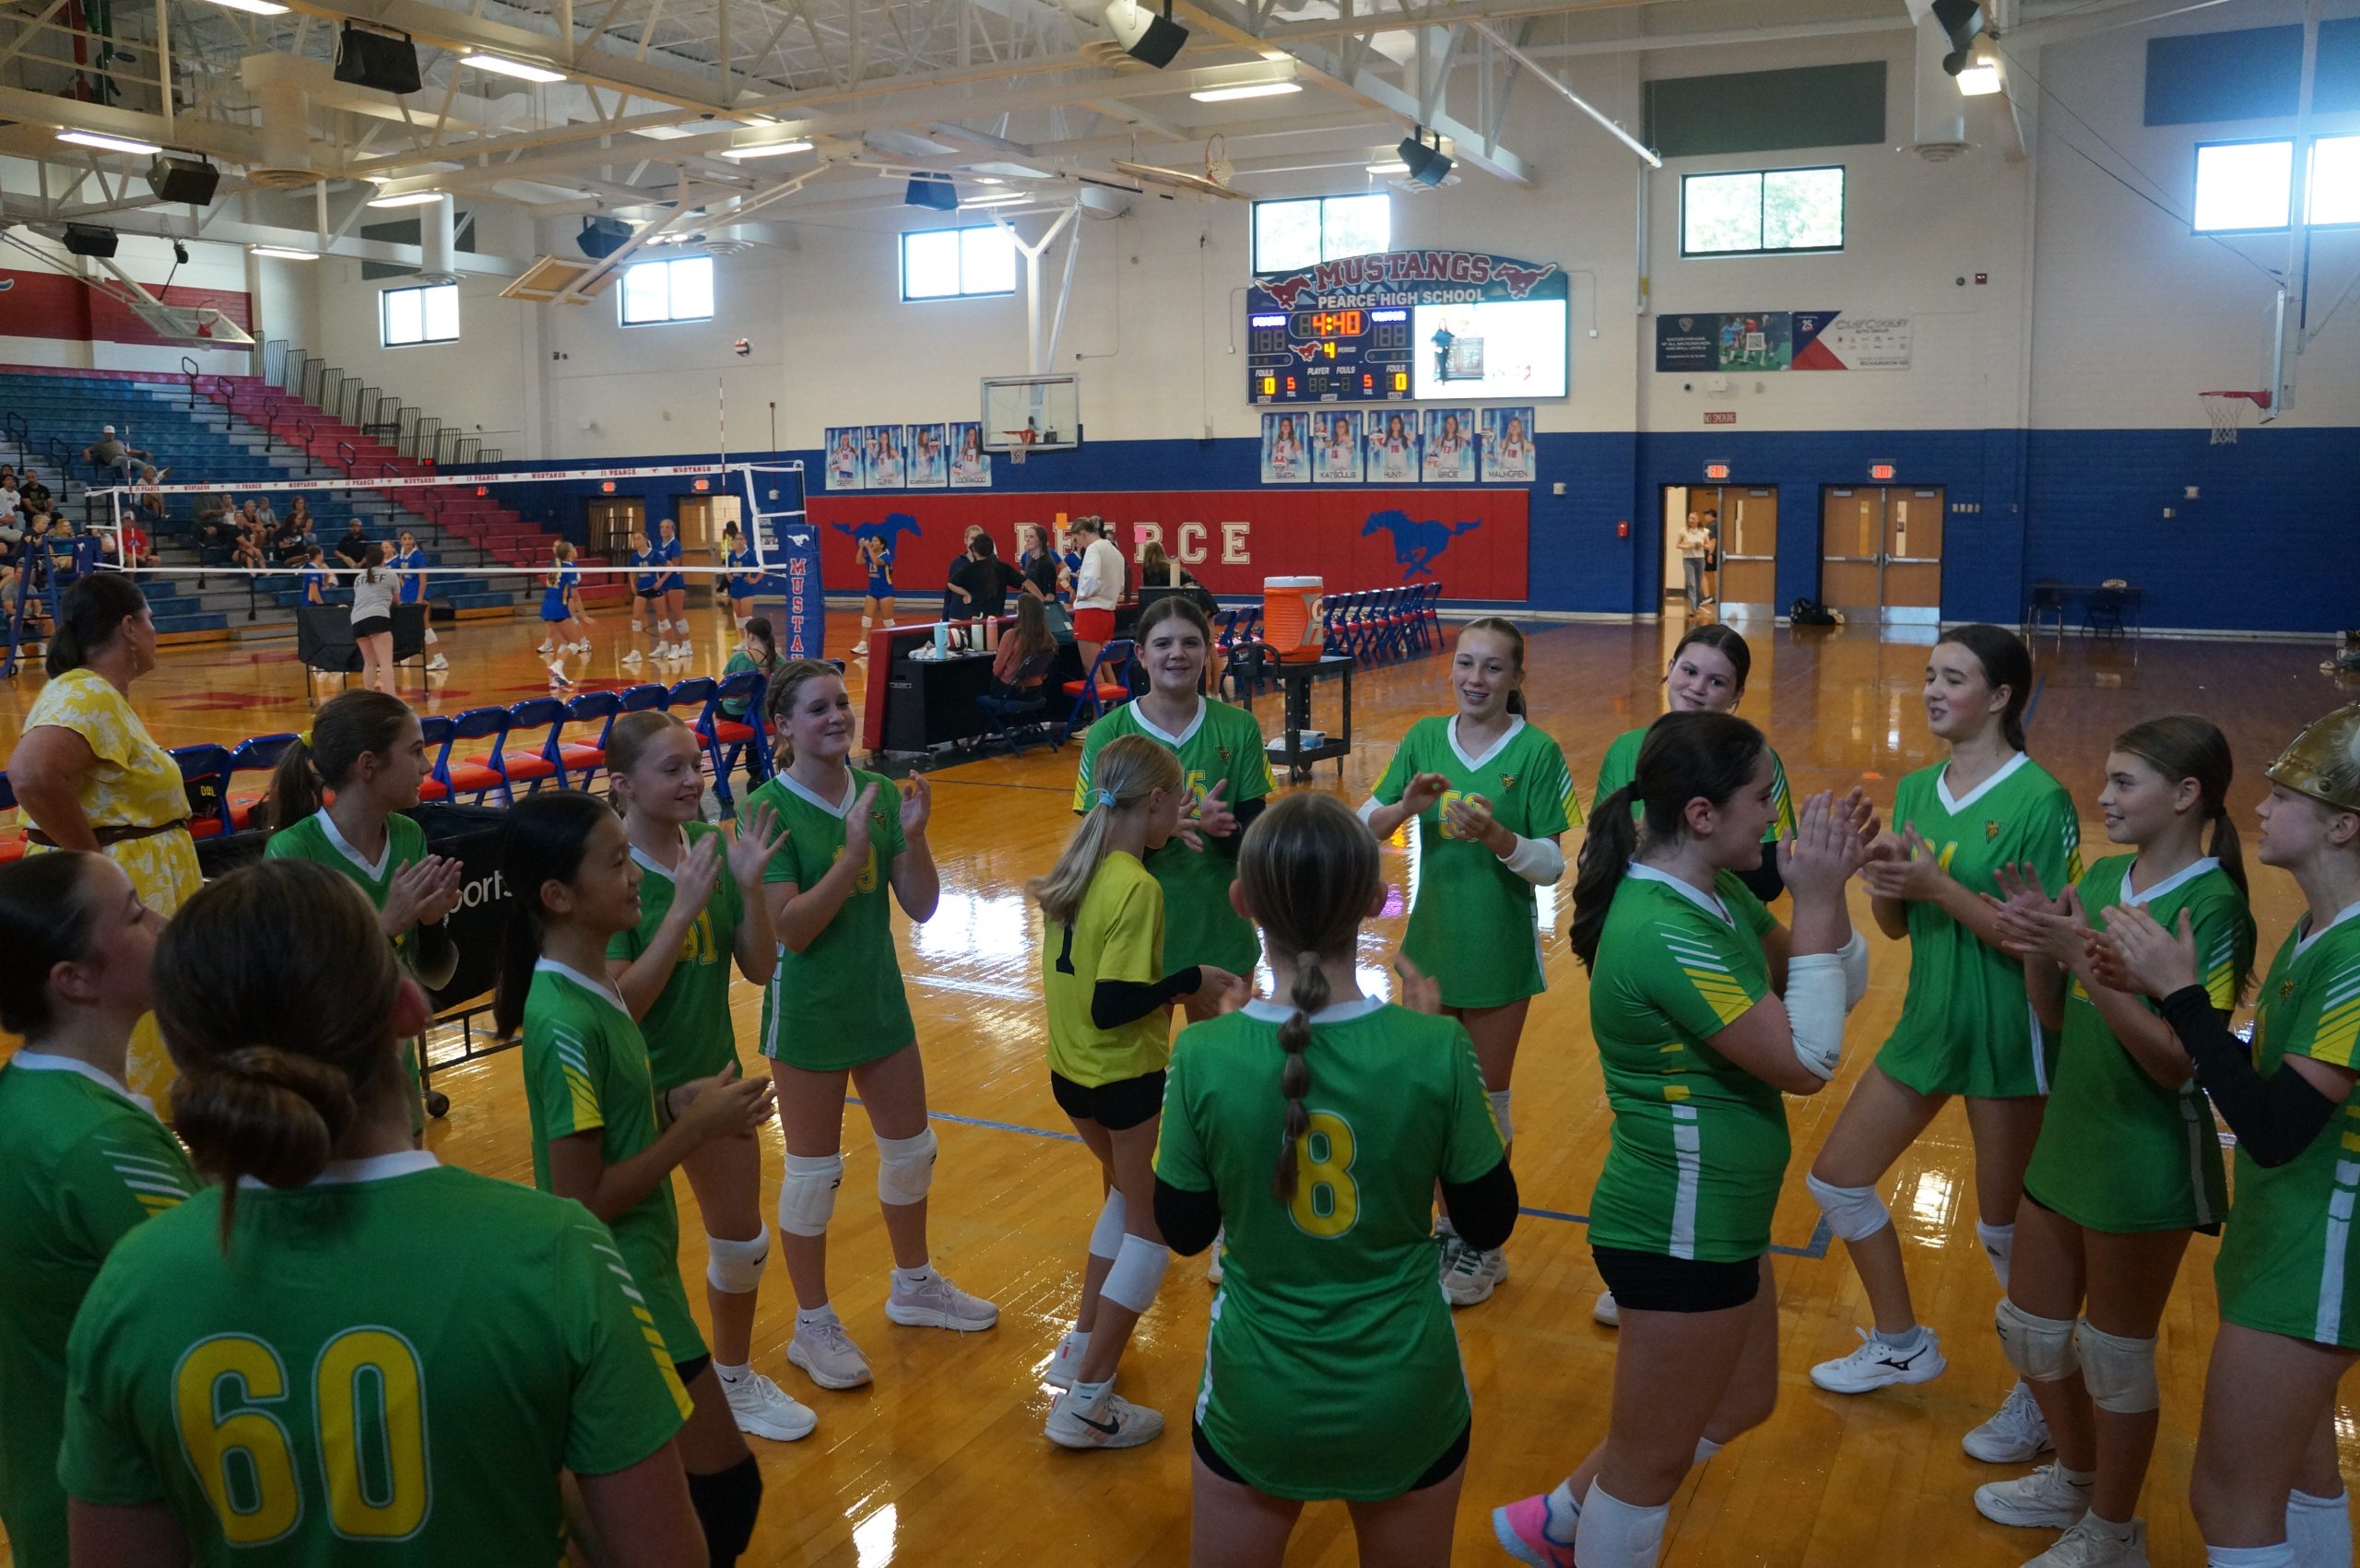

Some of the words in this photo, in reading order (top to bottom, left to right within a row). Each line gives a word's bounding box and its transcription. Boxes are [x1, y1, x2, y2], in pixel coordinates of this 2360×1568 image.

[1315, 252, 1491, 292] MUSTANGS
[1317, 294, 1375, 309] PEARCE
[1380, 291, 1418, 306] HIGH
[1422, 289, 1485, 304] SCHOOL
[1312, 310, 1362, 336] 4:40
[1323, 342, 1336, 360] 4
[1307, 367, 1330, 375] PLAYER
[1336, 366, 1355, 374] FOULS
[1282, 1109, 1361, 1240] 8
[171, 1324, 433, 1550] 60
